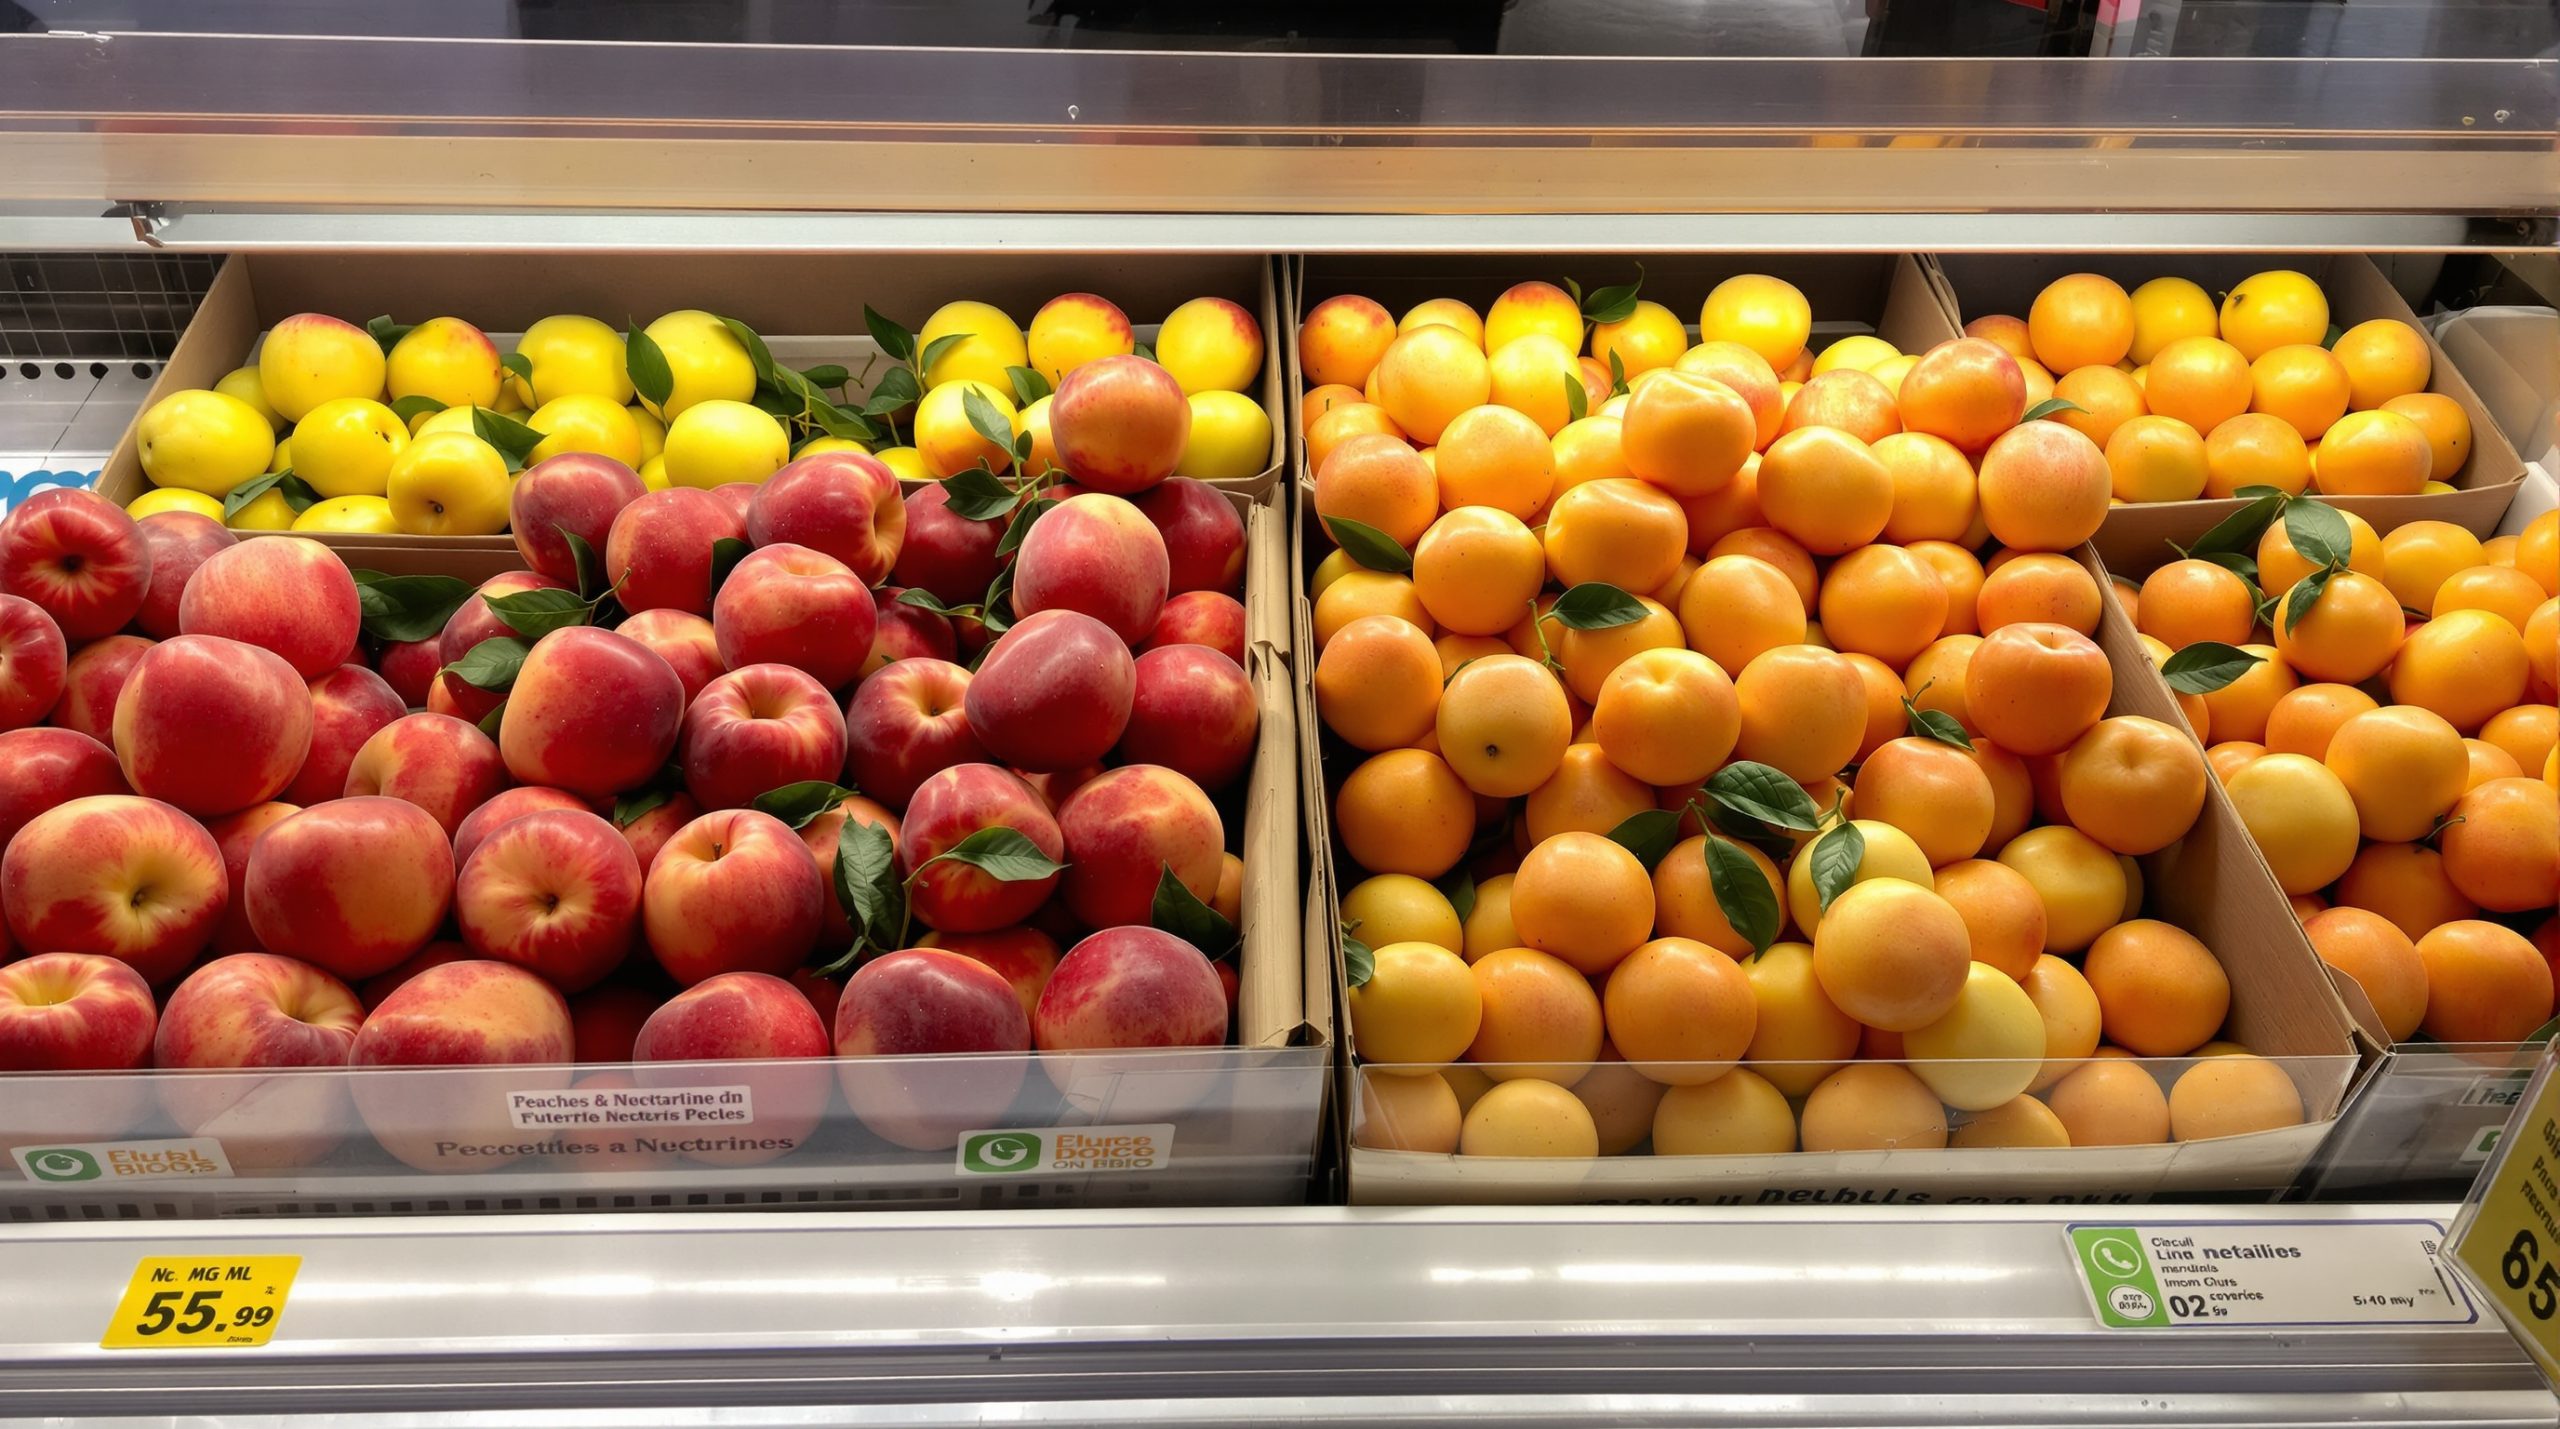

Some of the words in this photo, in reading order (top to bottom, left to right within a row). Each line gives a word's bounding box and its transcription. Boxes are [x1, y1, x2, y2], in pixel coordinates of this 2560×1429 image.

[513, 1095, 589, 1108] Peaches
[595, 1094, 608, 1107] &
[609, 1142, 627, 1154] a
[187, 1266, 221, 1282] MG
[225, 1266, 253, 1281] ML
[2169, 1295, 2209, 1318] 02
